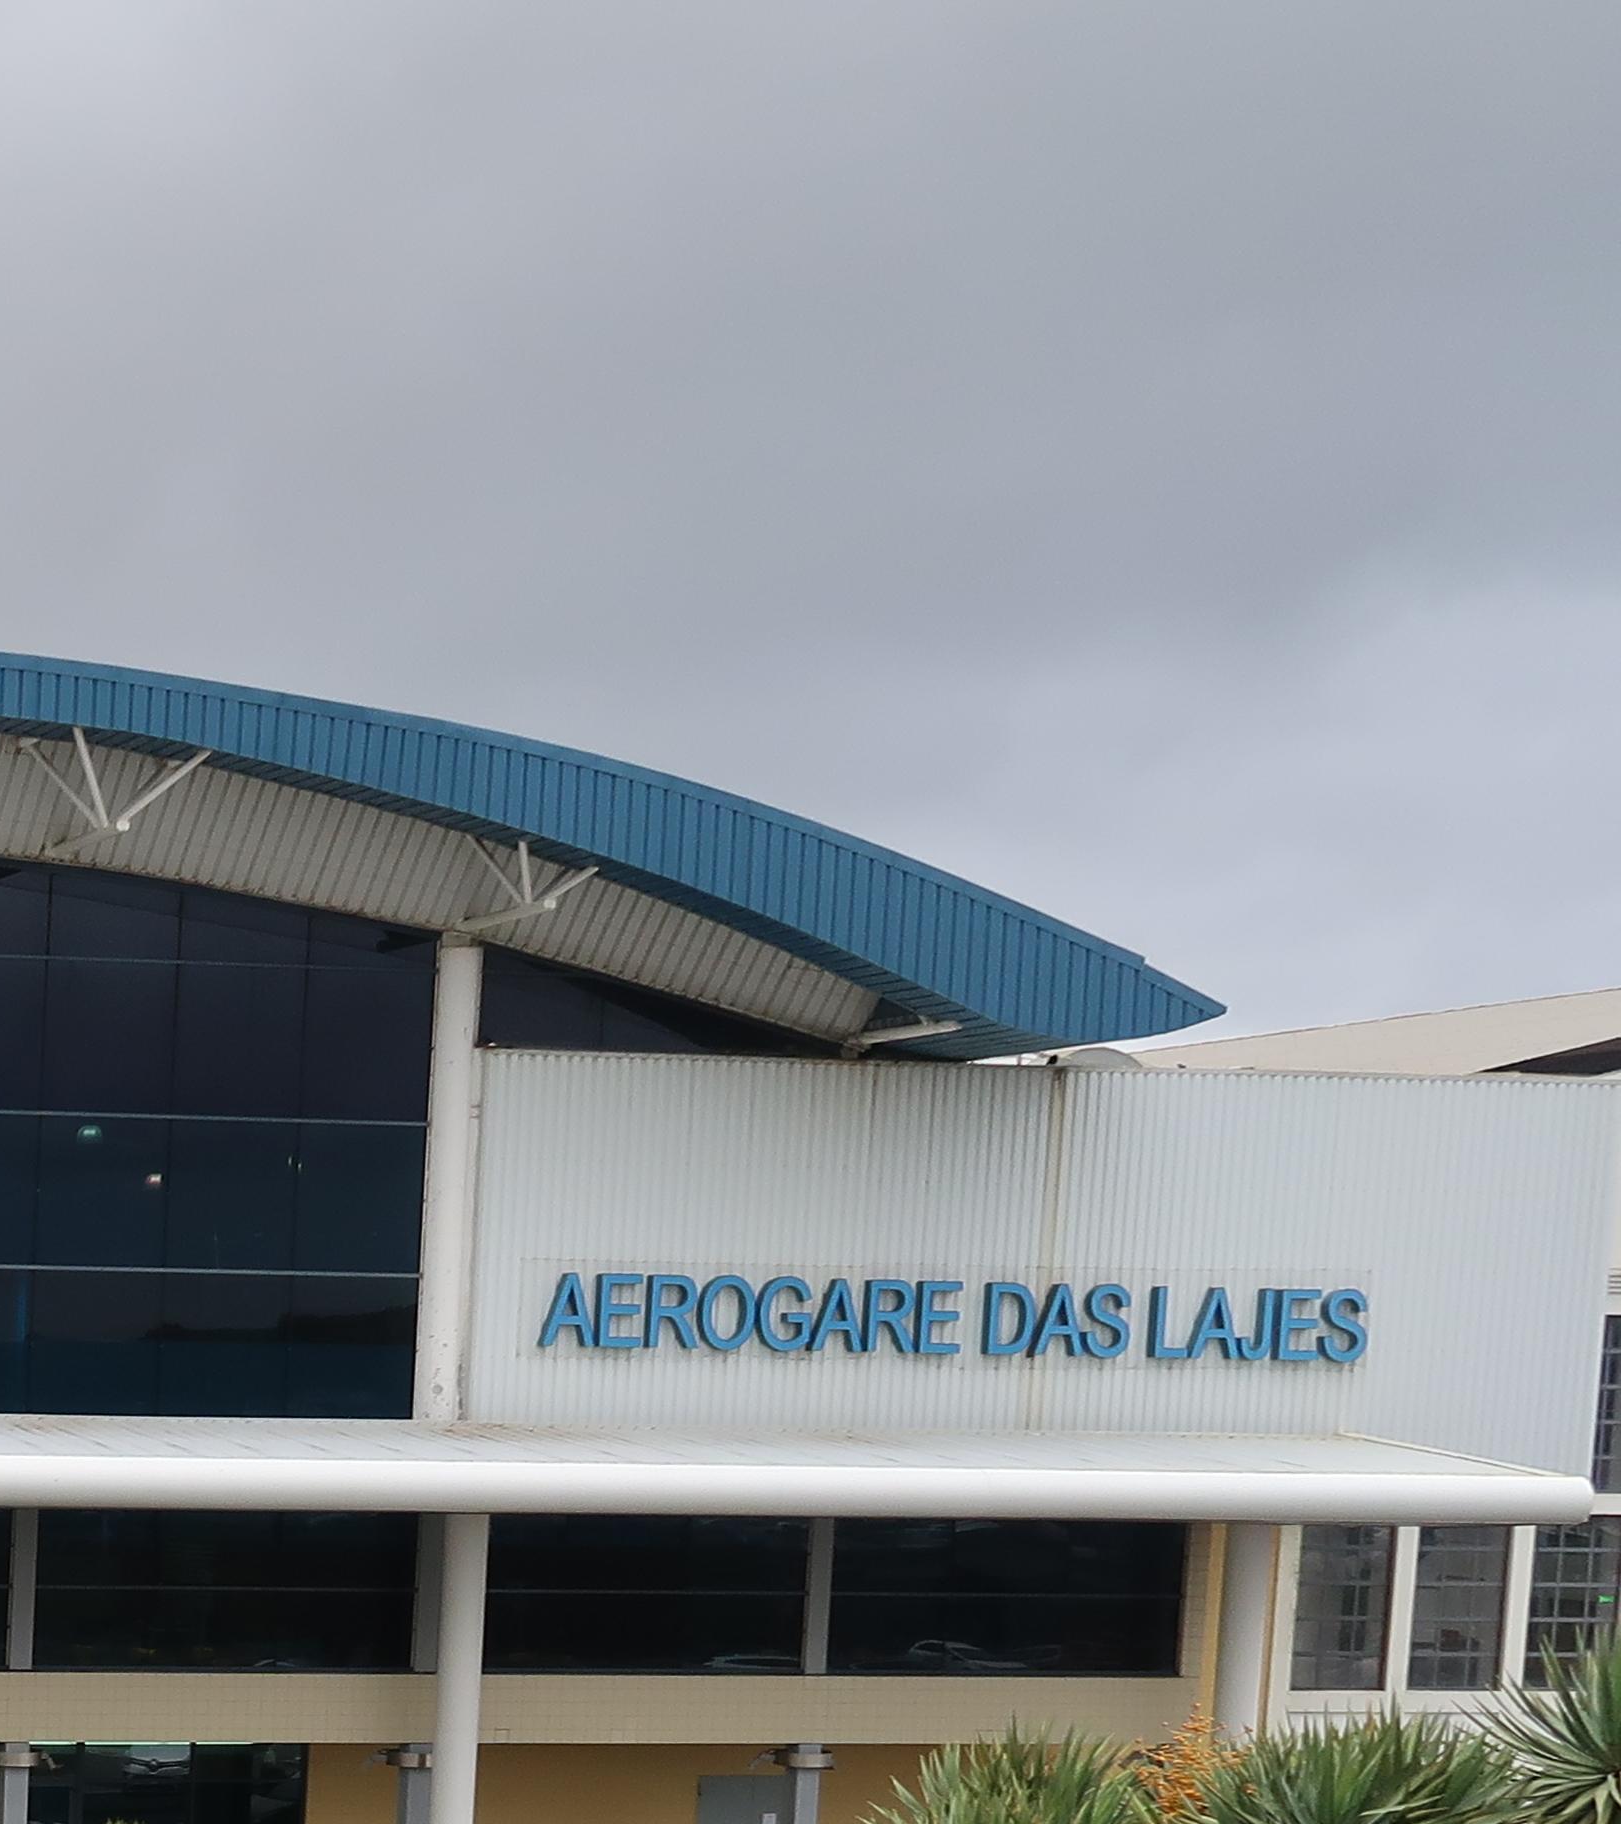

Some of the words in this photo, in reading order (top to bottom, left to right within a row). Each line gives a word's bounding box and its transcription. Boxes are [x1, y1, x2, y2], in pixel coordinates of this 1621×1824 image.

[537, 1272, 963, 1355] AEROGARE
[982, 1281, 1131, 1359] DAS
[1146, 1285, 1370, 1364] LAJES
